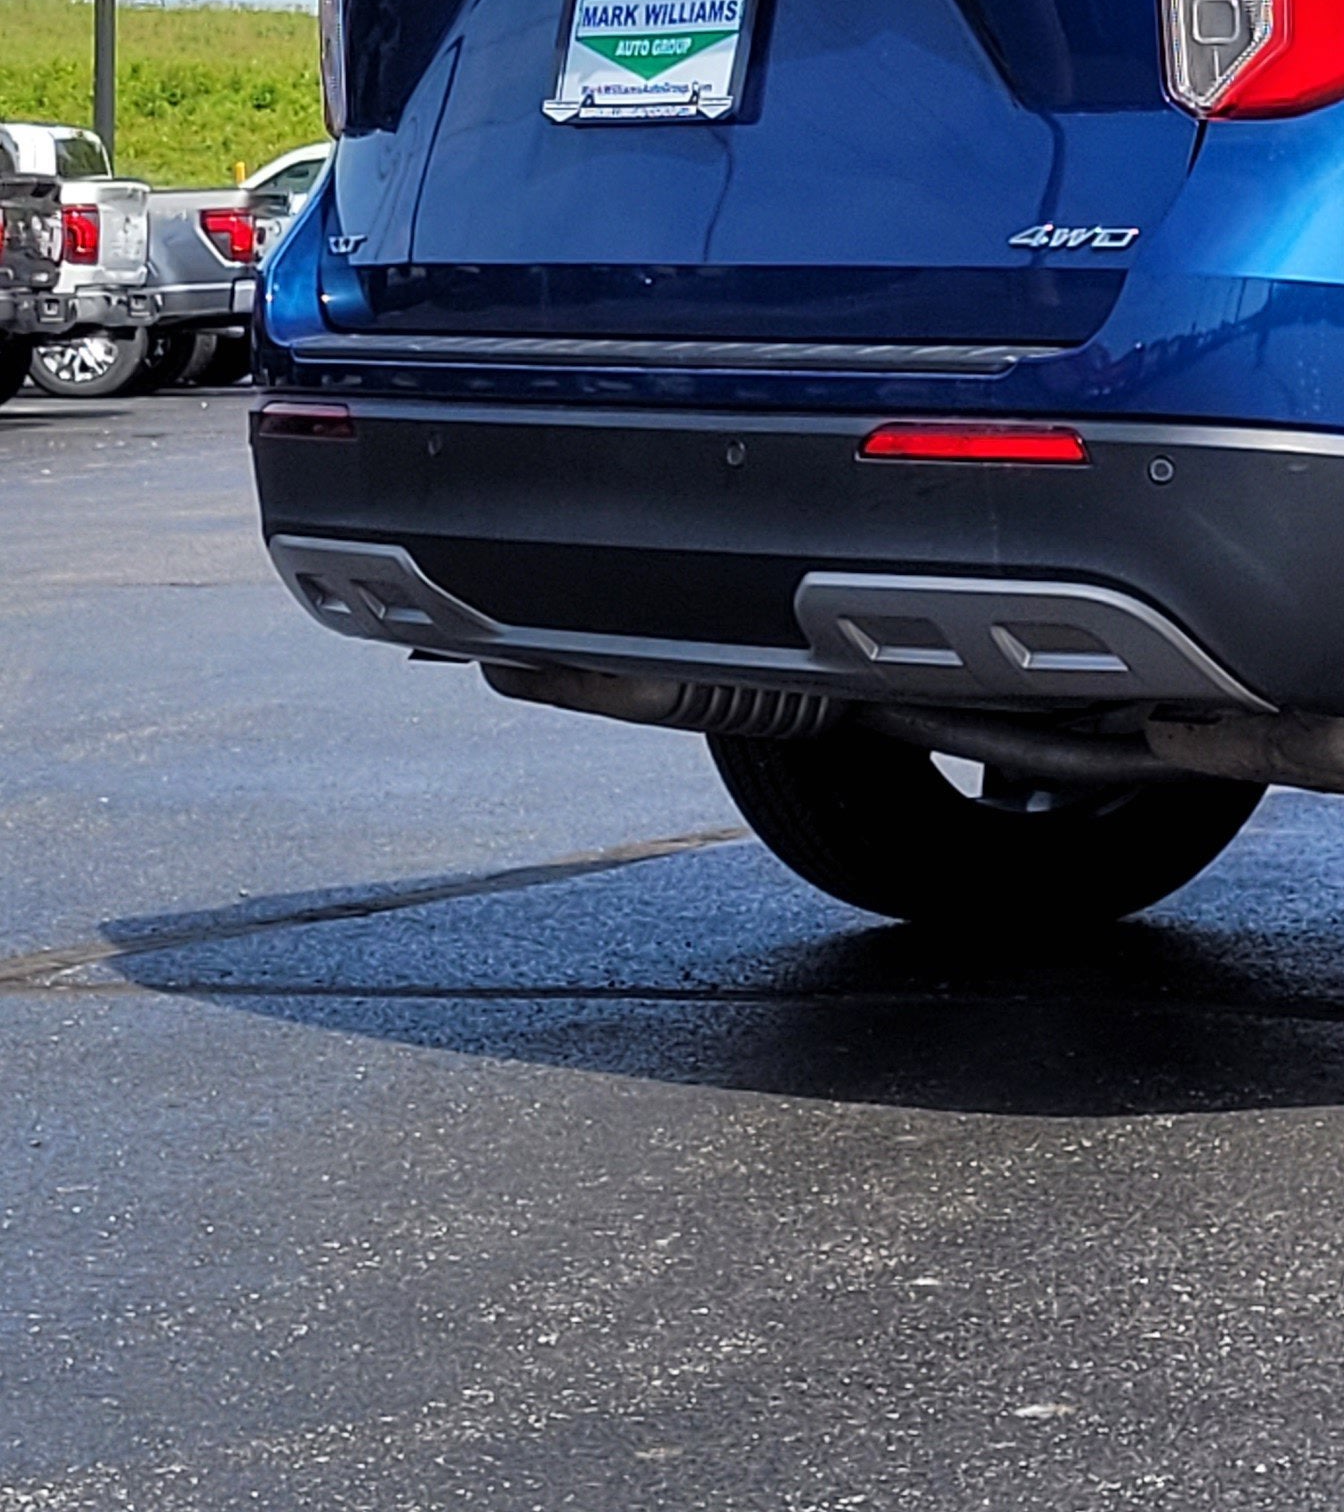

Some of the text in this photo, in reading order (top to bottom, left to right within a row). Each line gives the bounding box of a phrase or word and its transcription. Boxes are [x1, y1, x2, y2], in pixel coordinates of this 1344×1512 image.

[582, 0, 739, 27] MARK WILLIAMS
[614, 37, 692, 56] AUTO GROUP
[1008, 223, 1140, 247] 4WD
